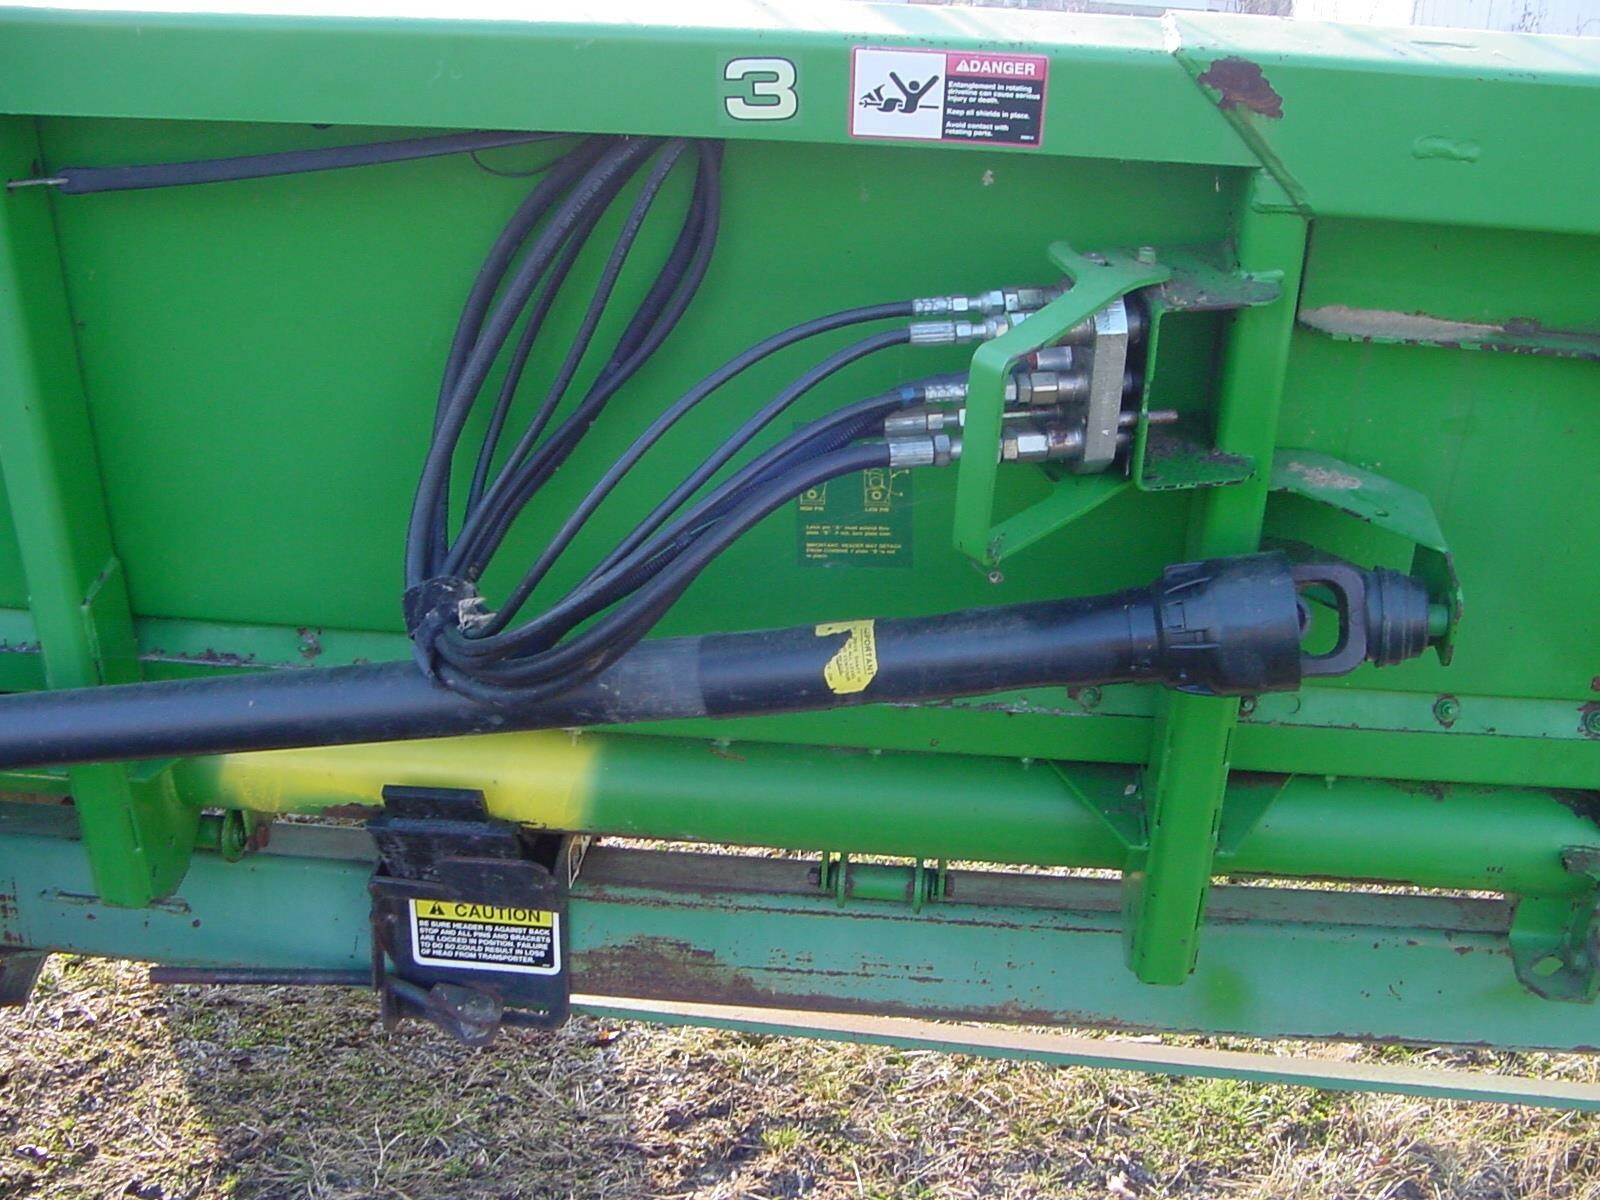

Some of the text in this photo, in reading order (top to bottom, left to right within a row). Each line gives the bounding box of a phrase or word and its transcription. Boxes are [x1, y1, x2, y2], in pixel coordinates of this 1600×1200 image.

[970, 60, 1035, 75] DANGER
[724, 57, 798, 121] 3
[948, 81, 996, 90] Entanglement
[1006, 85, 1032, 93] rotating
[947, 95, 967, 103] injury
[947, 108, 965, 117] Keep
[945, 129, 972, 137] rotating
[455, 904, 540, 922] CAUTION
[431, 920, 451, 928] SURE
[453, 922, 484, 931] HEADER
[494, 925, 527, 934] AGAINST
[529, 928, 550, 936] BACK
[420, 927, 439, 935] STOP
[510, 934, 551, 943] BRACKETS
[437, 936, 467, 944] LOCKED
[516, 941, 548, 950] FAILURE
[455, 951, 477, 959] FROM
[478, 952, 535, 963] TRANSPORTER.
[485, 946, 513, 955] RESULT
